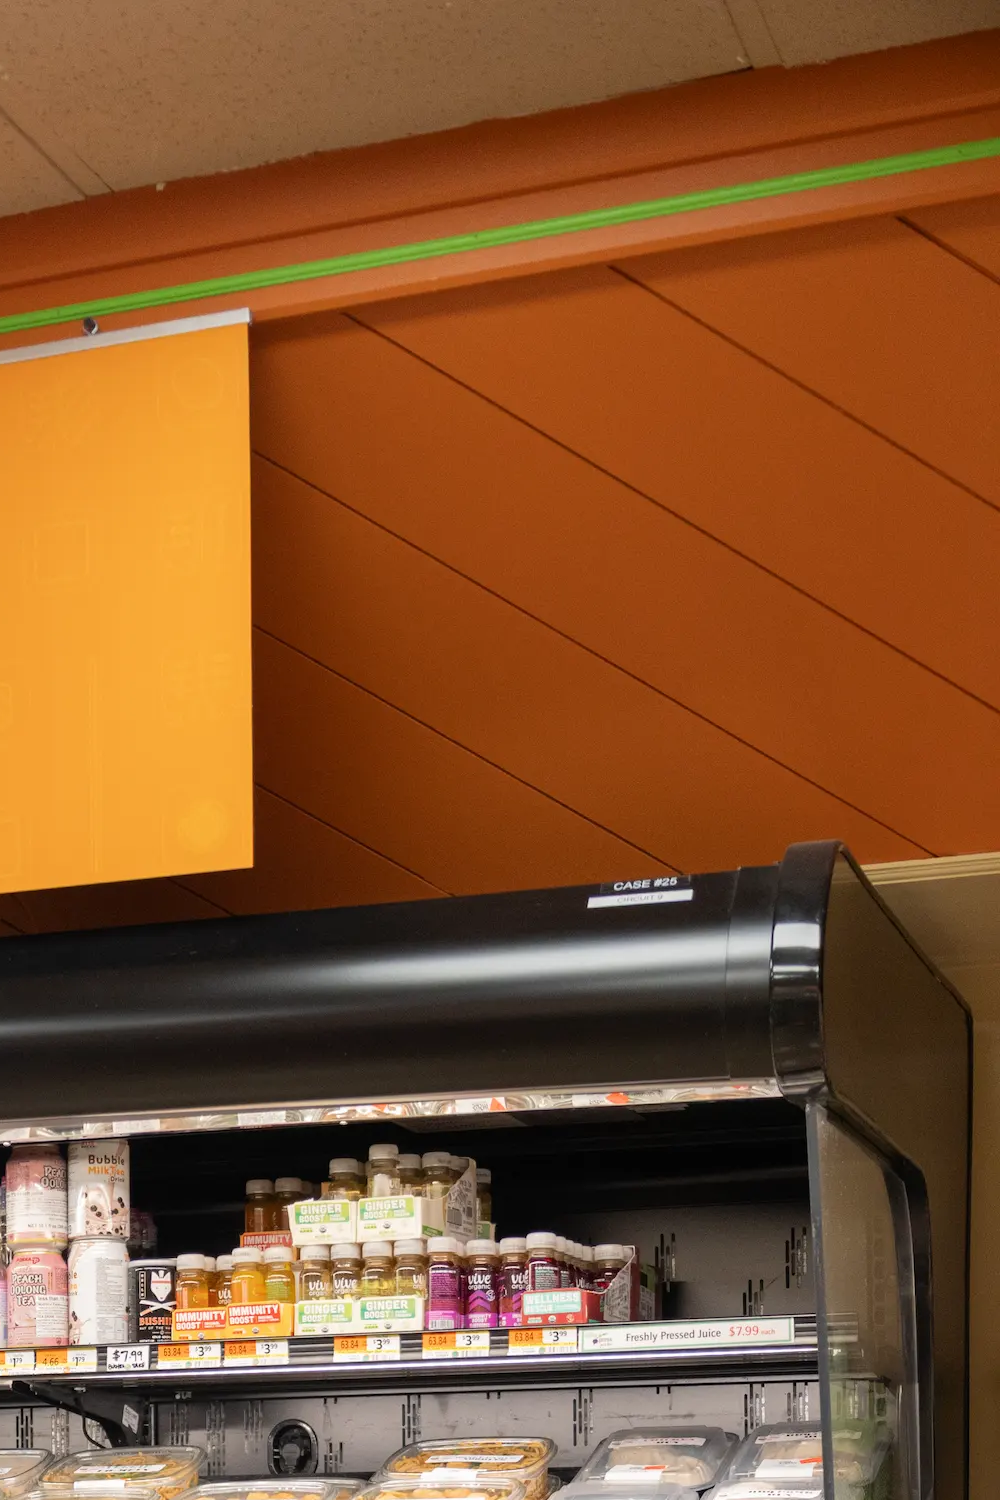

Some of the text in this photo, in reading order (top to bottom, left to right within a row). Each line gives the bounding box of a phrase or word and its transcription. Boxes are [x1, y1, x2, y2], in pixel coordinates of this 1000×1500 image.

[613, 876, 678, 891] CASE #25
[88, 1154, 125, 1166] Bubble
[88, 1166, 109, 1175] Milk
[300, 1203, 342, 1215] GINGER
[365, 1199, 406, 1211] GINGER
[299, 1214, 325, 1224] BOOST
[363, 1210, 389, 1220] BOOST
[243, 1233, 291, 1246] IMMUNITY
[11, 1272, 43, 1284] PEACH
[467, 1272, 491, 1285] vive
[10, 1284, 47, 1295] OOLONG
[467, 1283, 491, 1291] organic
[16, 1295, 36, 1306] TEA
[524, 1292, 579, 1304] WELLNESS
[228, 1304, 279, 1317] IMMUNITY
[303, 1303, 345, 1315] GINGER
[365, 1300, 408, 1311] GINGER
[175, 1310, 226, 1323] IMMUNITY
[229, 1315, 255, 1325] BOOST
[302, 1314, 327, 1323] BOOST
[364, 1310, 390, 1320] BOOST
[175, 1321, 201, 1331] BOOST
[514, 1332, 534, 1342] 63.84
[625, 1331, 658, 1343] Freshly
[660, 1329, 695, 1340] Pressed
[697, 1328, 722, 1339] Juice
[729, 1325, 759, 1337] $7.99
[761, 1328, 776, 1336] each
[340, 1340, 359, 1349] 63.84
[428, 1336, 447, 1345] 63.84
[163, 1347, 181, 1357] 63.84
[228, 1345, 247, 1354] 63.84
[112, 1349, 143, 1362] $7.99
[42, 1357, 59, 1366] 4.66
